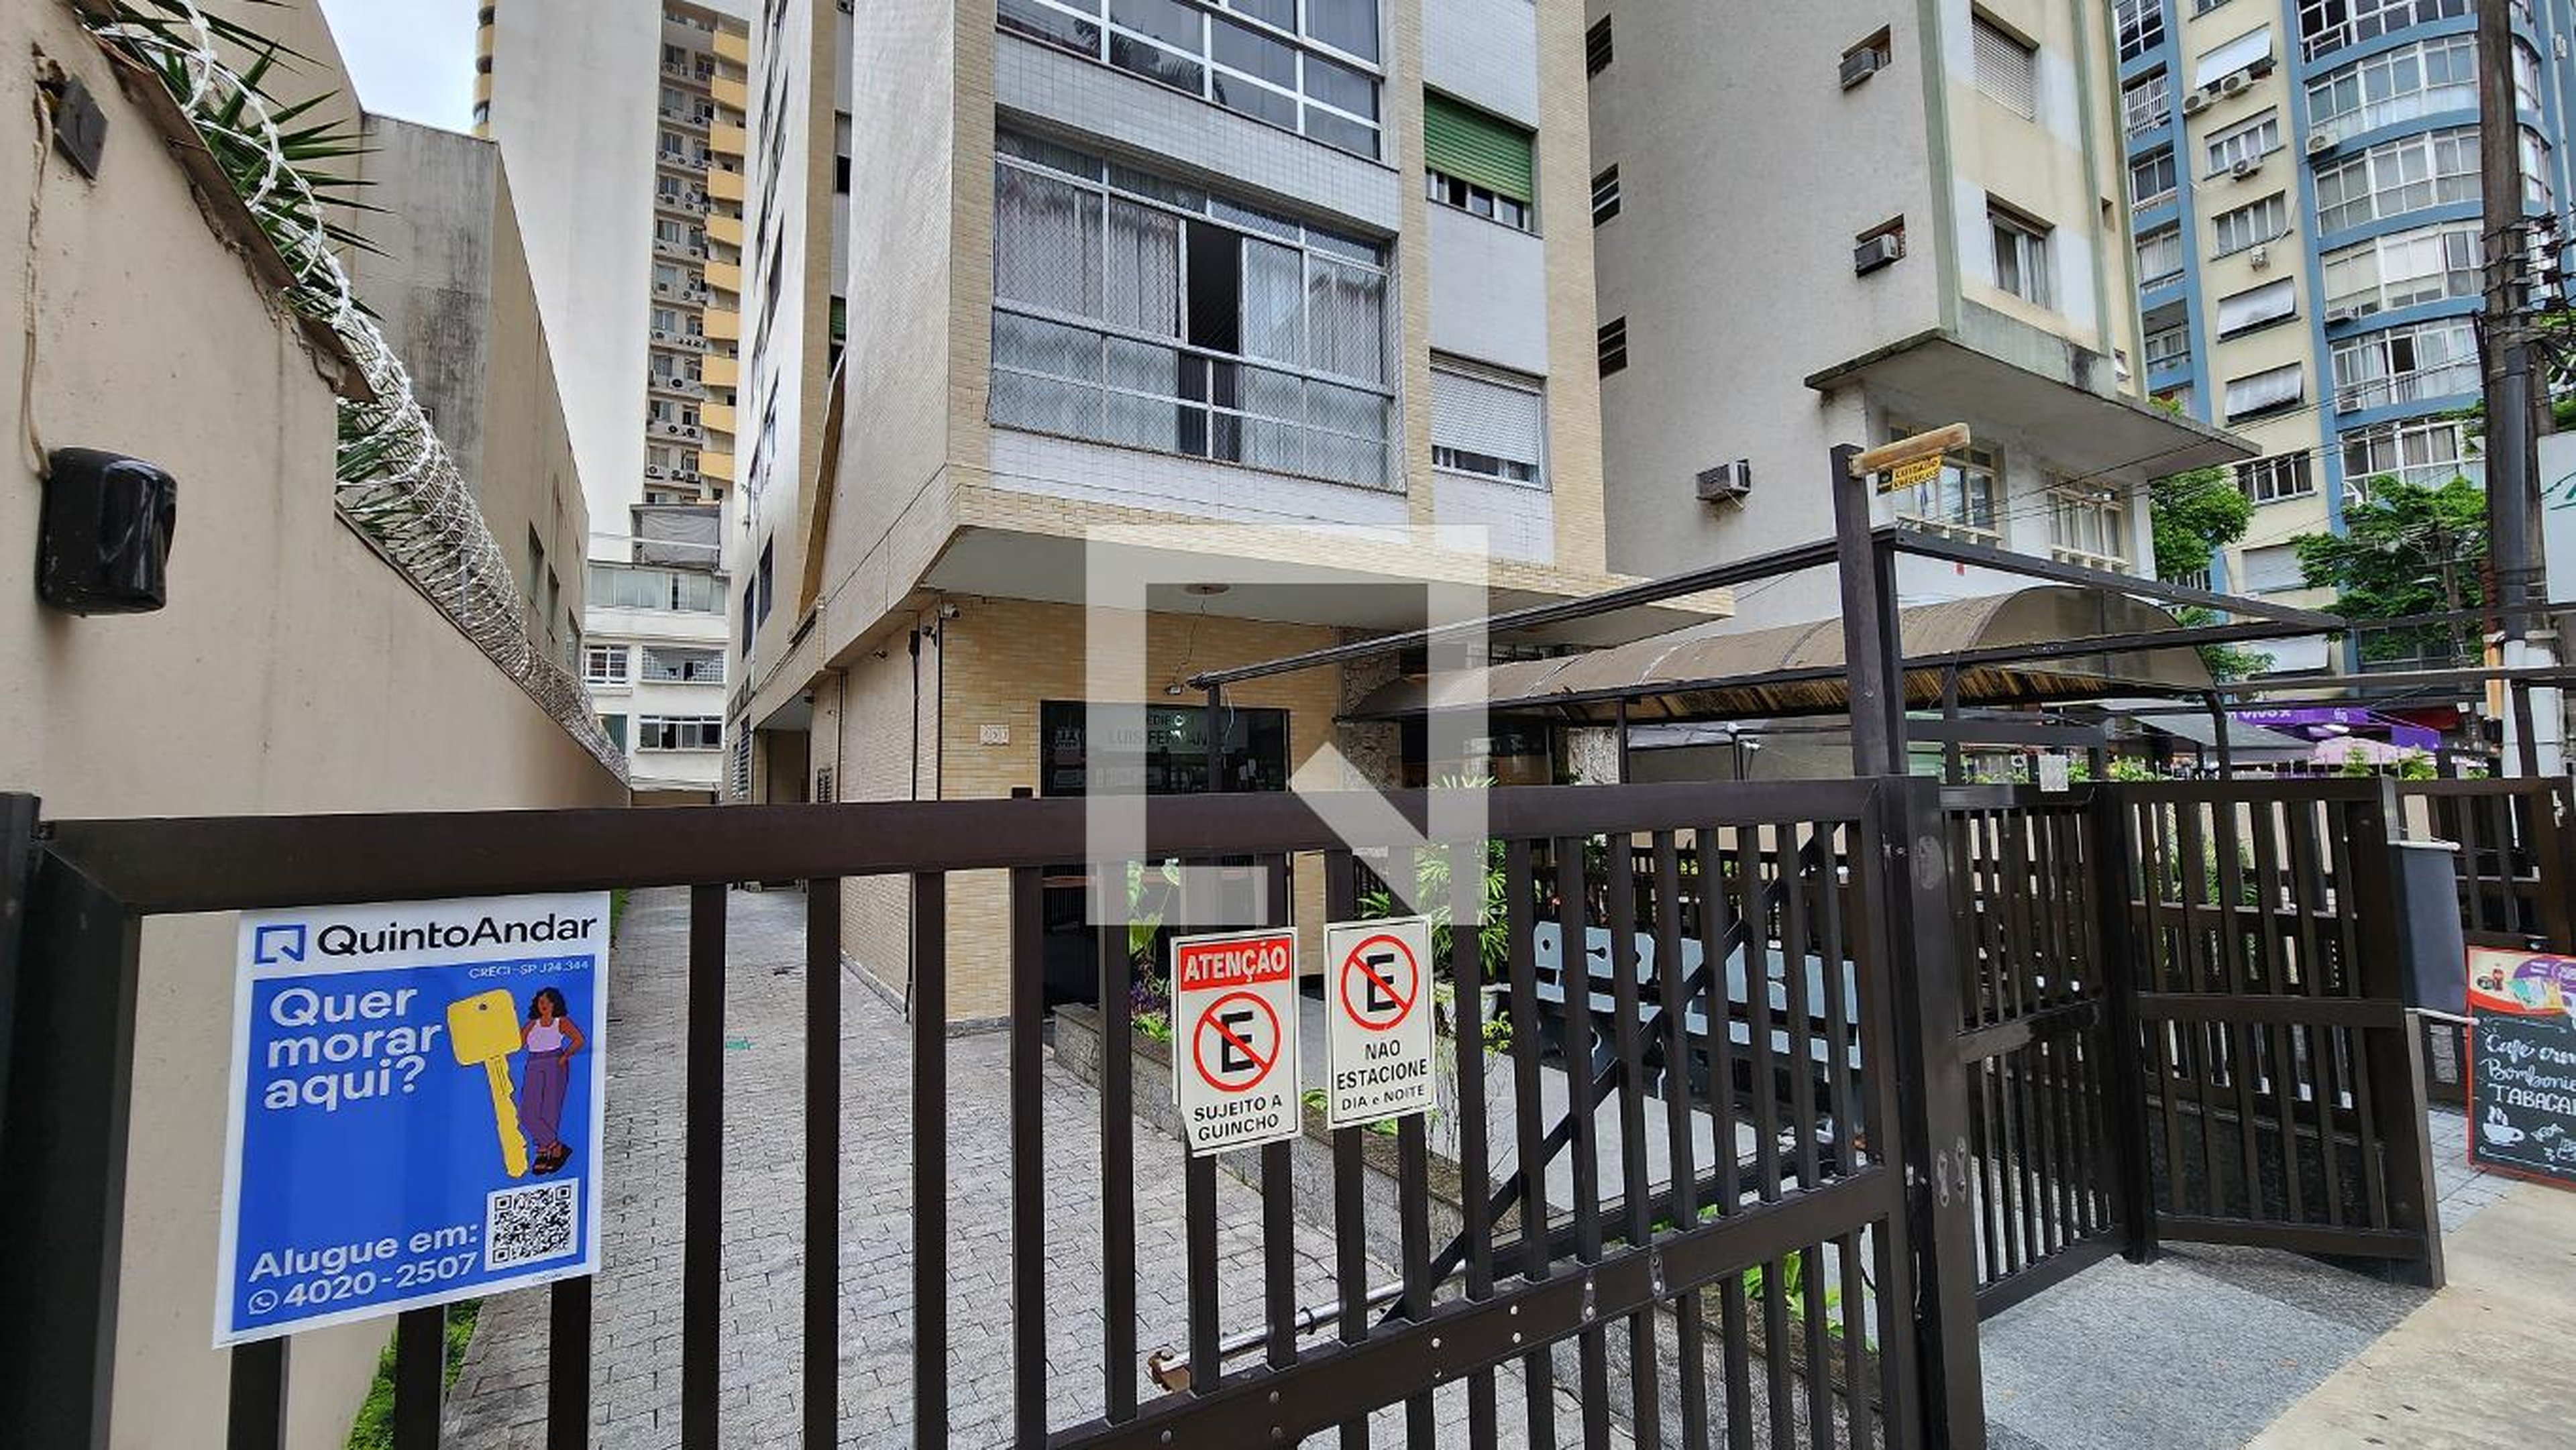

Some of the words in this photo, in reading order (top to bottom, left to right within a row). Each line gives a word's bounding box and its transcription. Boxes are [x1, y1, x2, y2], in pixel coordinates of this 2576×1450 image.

[317, 913, 597, 956] QuintoAndar
[1183, 941, 1287, 983] ATENÇÃO
[1366, 953, 1396, 1012] E
[270, 987, 417, 1026] Quer
[268, 1024, 441, 1068] morar
[1221, 1011, 1254, 1073] E
[264, 1057, 426, 1111] aqui?
[1337, 1058, 1428, 1090] ESTACIONE
[1193, 1099, 1266, 1123] SUJEITO
[1271, 1094, 1283, 1108] A
[1341, 1095, 1367, 1111] DIA
[1383, 1084, 1425, 1104] NOITE
[1197, 1114, 1279, 1141] GUINCHO
[248, 1237, 397, 1282] Alugue
[409, 1223, 478, 1251] em:
[283, 1252, 478, 1306] 4020-2507
